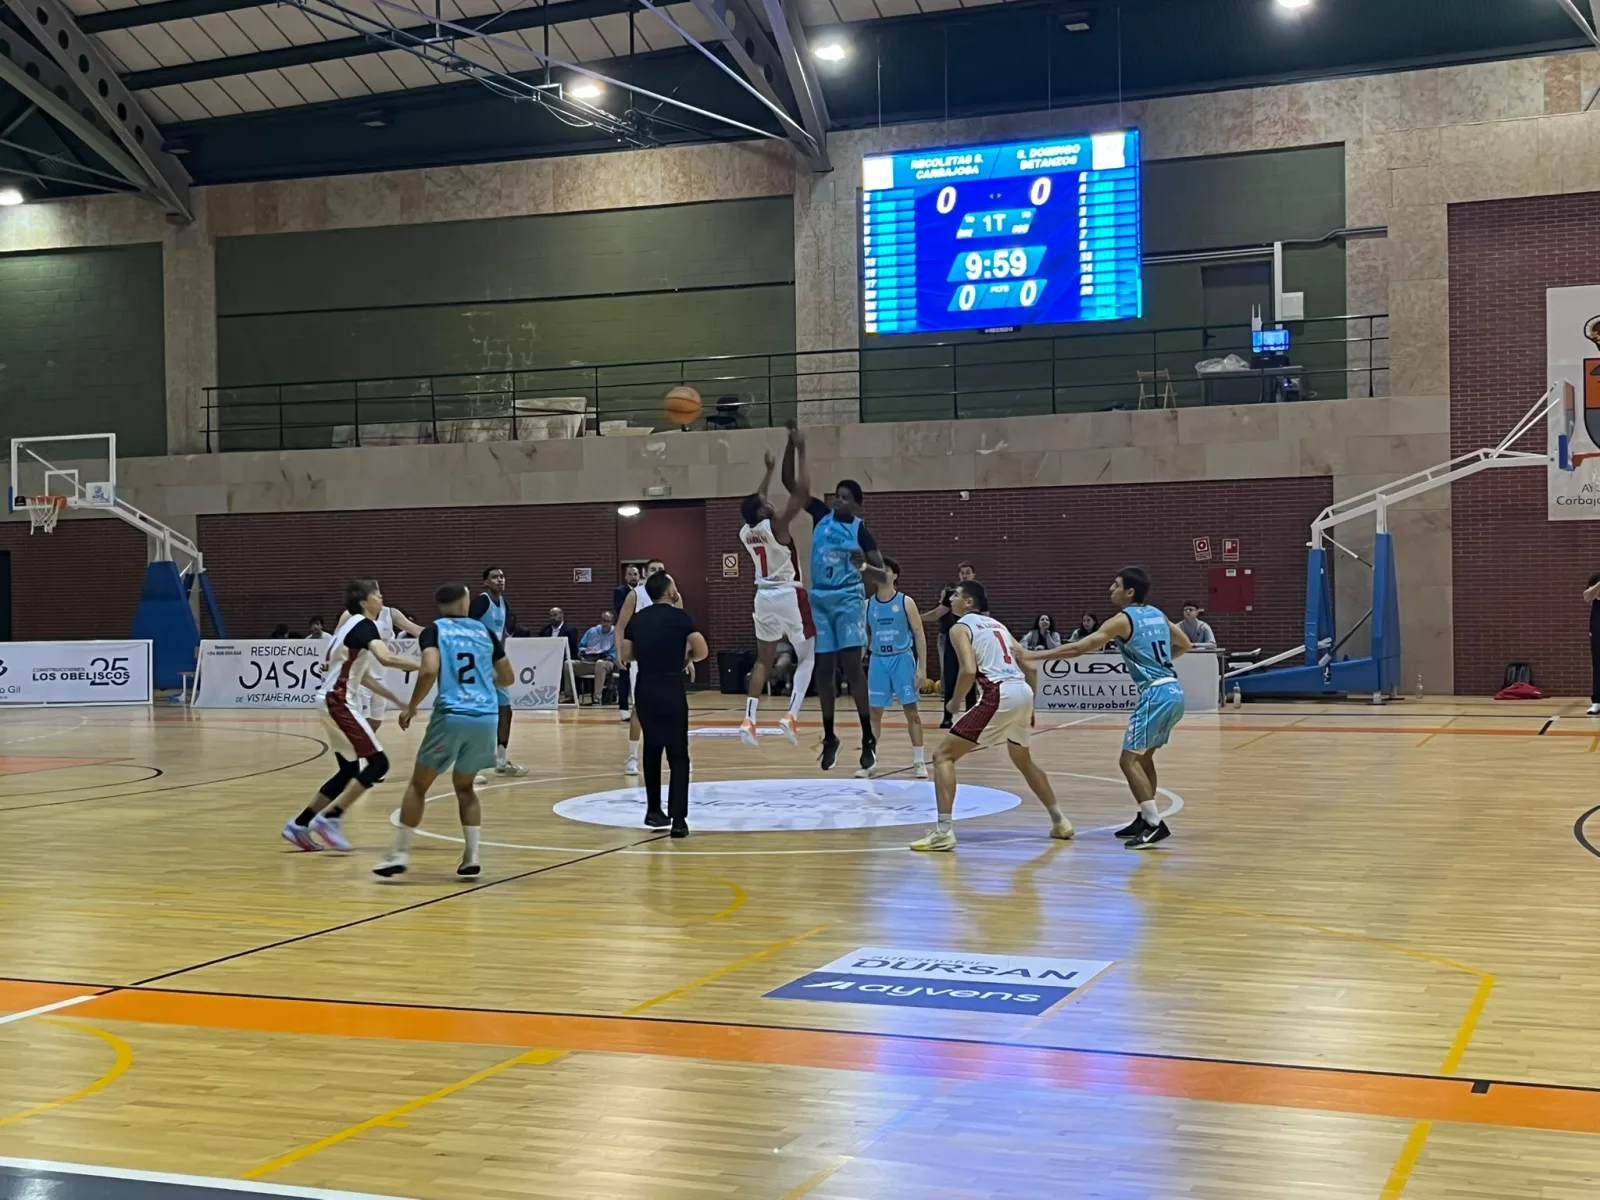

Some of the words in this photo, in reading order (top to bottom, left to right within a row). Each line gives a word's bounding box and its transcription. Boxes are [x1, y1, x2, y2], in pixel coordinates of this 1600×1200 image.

[936, 186, 957, 214] 0
[1030, 177, 1052, 206] 0
[982, 214, 1006, 232] 1T
[965, 248, 1027, 280] 9:59
[959, 285, 976, 310] 0
[1020, 280, 1037, 306] 0
[753, 546, 768, 578] 7
[250, 646, 319, 657] RESIDENCIAL
[992, 631, 1012, 664] 1
[1151, 640, 1174, 668] 15
[32, 672, 56, 682] LOS
[60, 671, 130, 681] OBELISCOS
[90, 658, 129, 686] 25
[457, 652, 476, 684] 2
[1074, 662, 1130, 674] LEX
[8, 686, 21, 694] Gil
[247, 692, 316, 704] VISTAHERMOS
[1043, 684, 1104, 696] CASTILLA
[1106, 684, 1116, 696] Y
[1122, 684, 1143, 696] LE
[1048, 700, 1136, 710] www.grupobafe
[851, 958, 1079, 980] DURSAN
[871, 955, 985, 965] automotor
[858, 984, 1042, 1002] ayvens
